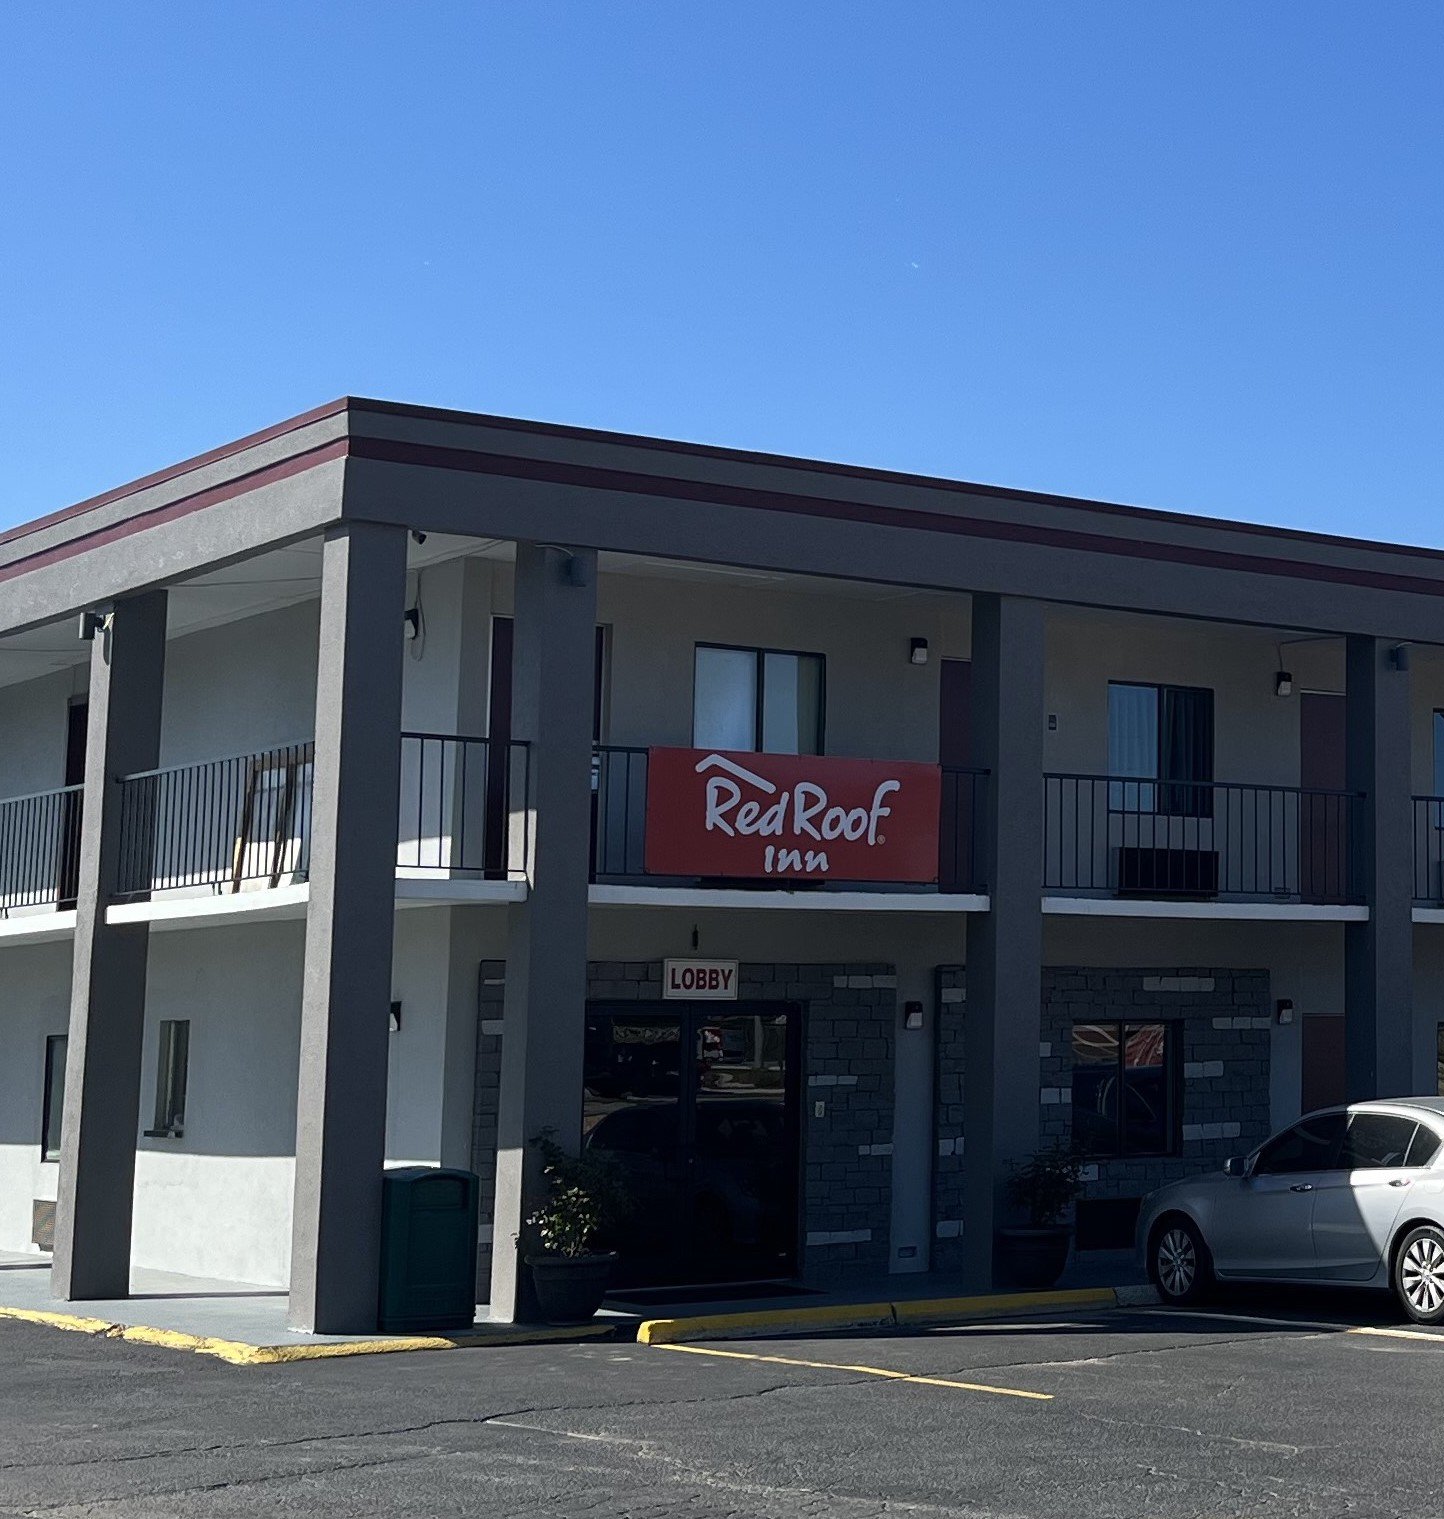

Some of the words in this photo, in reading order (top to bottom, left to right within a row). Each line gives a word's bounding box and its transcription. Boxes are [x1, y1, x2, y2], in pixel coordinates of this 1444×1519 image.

[705, 776, 789, 837] Red
[794, 779, 900, 845] Roof
[671, 967, 733, 990] LOBBY
